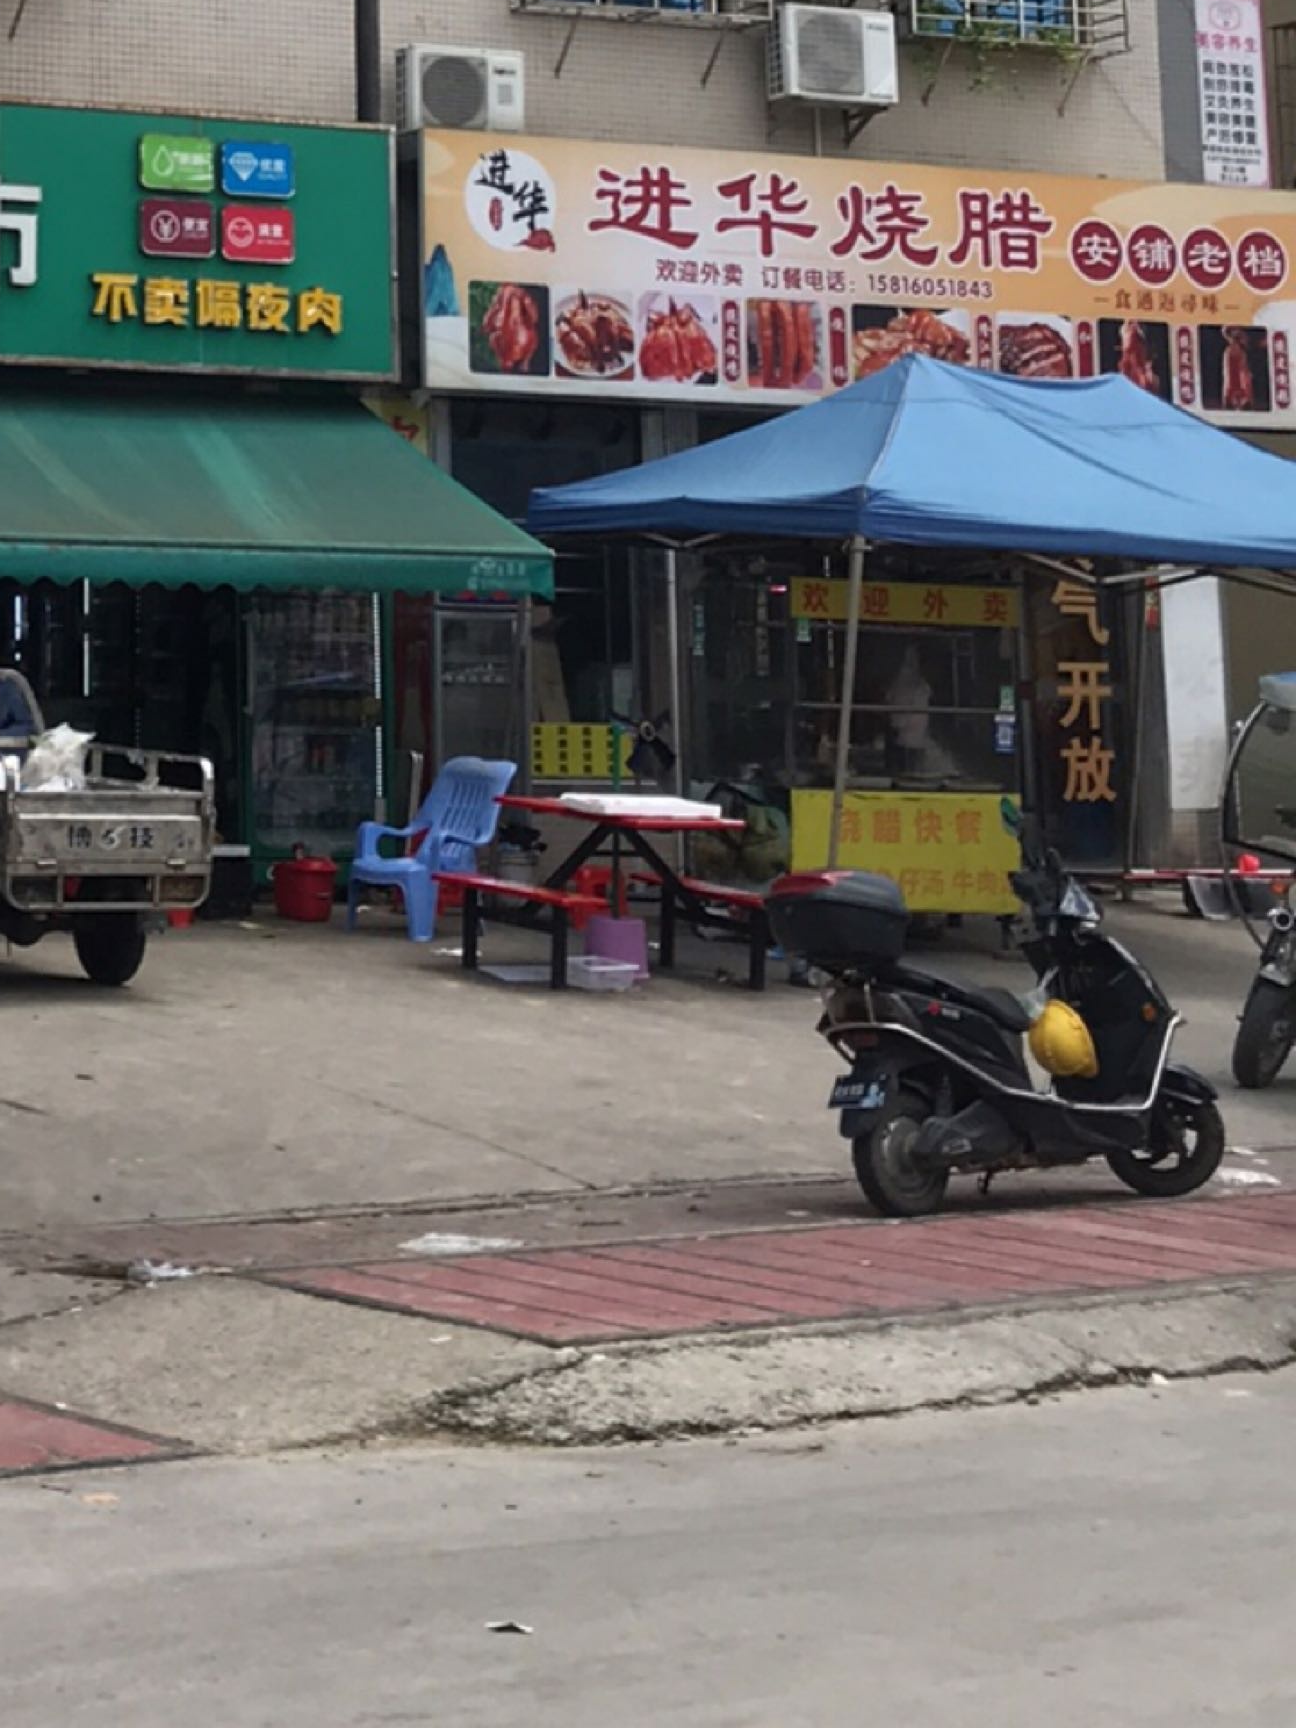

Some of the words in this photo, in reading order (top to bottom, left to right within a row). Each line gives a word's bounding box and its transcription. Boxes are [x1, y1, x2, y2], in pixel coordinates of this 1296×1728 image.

[588, 165, 1054, 269] 进华烧腊
[655, 258, 744, 286] 欢迎外卖
[867, 273, 993, 299] 15816051843
[1075, 232, 1283, 278] 安铺老档
[92, 272, 344, 334] 不卖隔夜肉
[801, 582, 1009, 622] 欢迎外卖
[1051, 557, 1118, 804] 气开放
